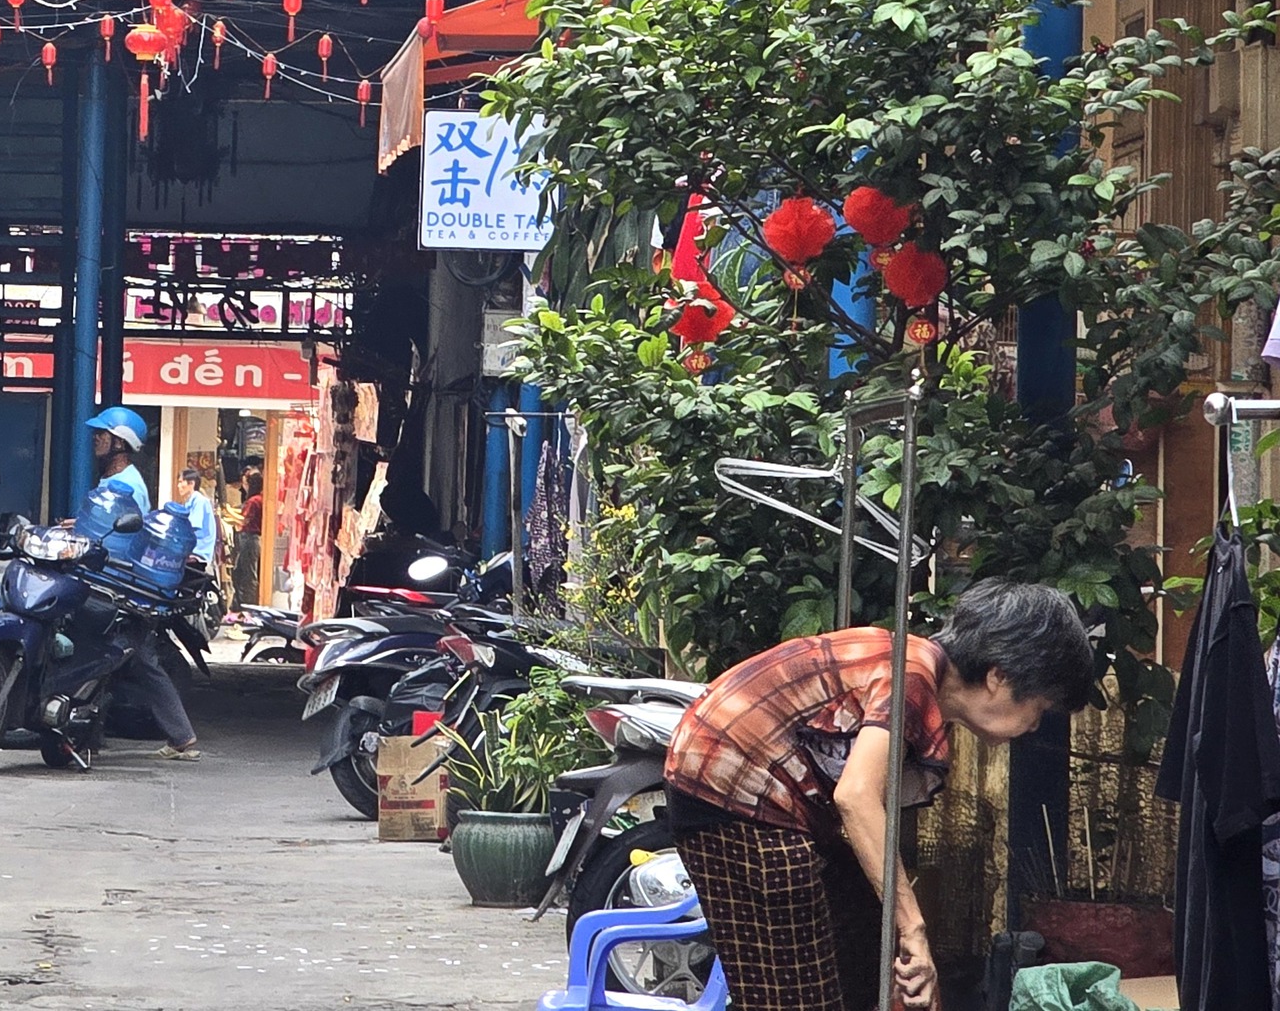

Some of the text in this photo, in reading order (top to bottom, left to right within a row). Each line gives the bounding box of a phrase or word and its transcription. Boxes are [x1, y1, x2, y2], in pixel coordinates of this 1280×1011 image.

[427, 211, 551, 230] DOUBLE TAP
[426, 229, 456, 239] TEA
[468, 230, 475, 239] &
[160, 349, 261, 386] đến
